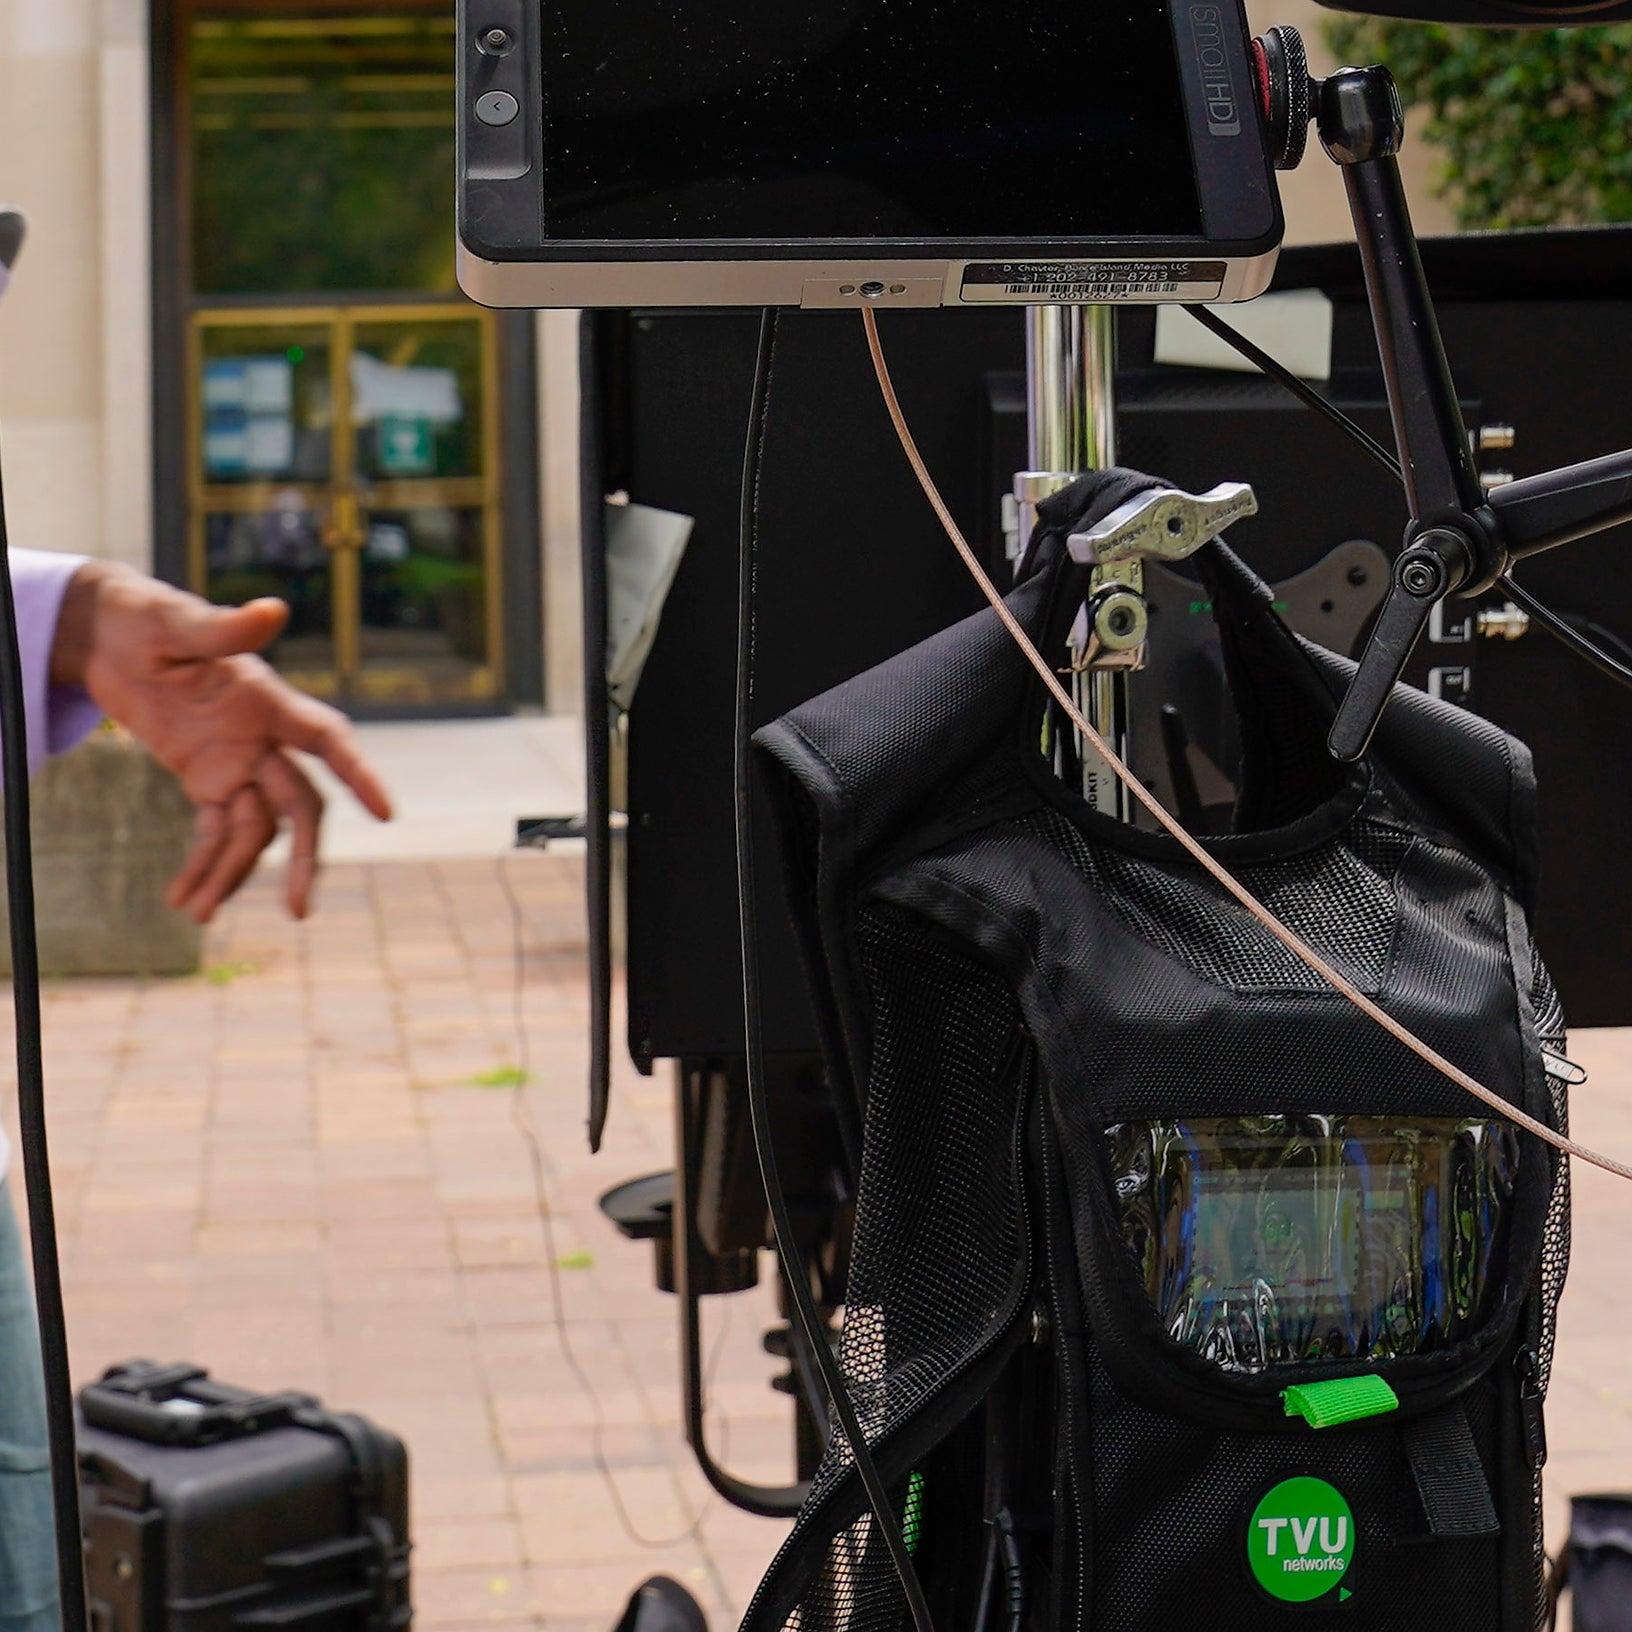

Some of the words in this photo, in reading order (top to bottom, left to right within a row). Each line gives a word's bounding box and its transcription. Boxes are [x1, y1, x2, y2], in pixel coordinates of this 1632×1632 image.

[1192, 8, 1235, 121] smallHD
[1046, 271, 1169, 282] 202-491-8783
[1258, 1516, 1348, 1556] TVU
[1282, 1554, 1345, 1572] networks
